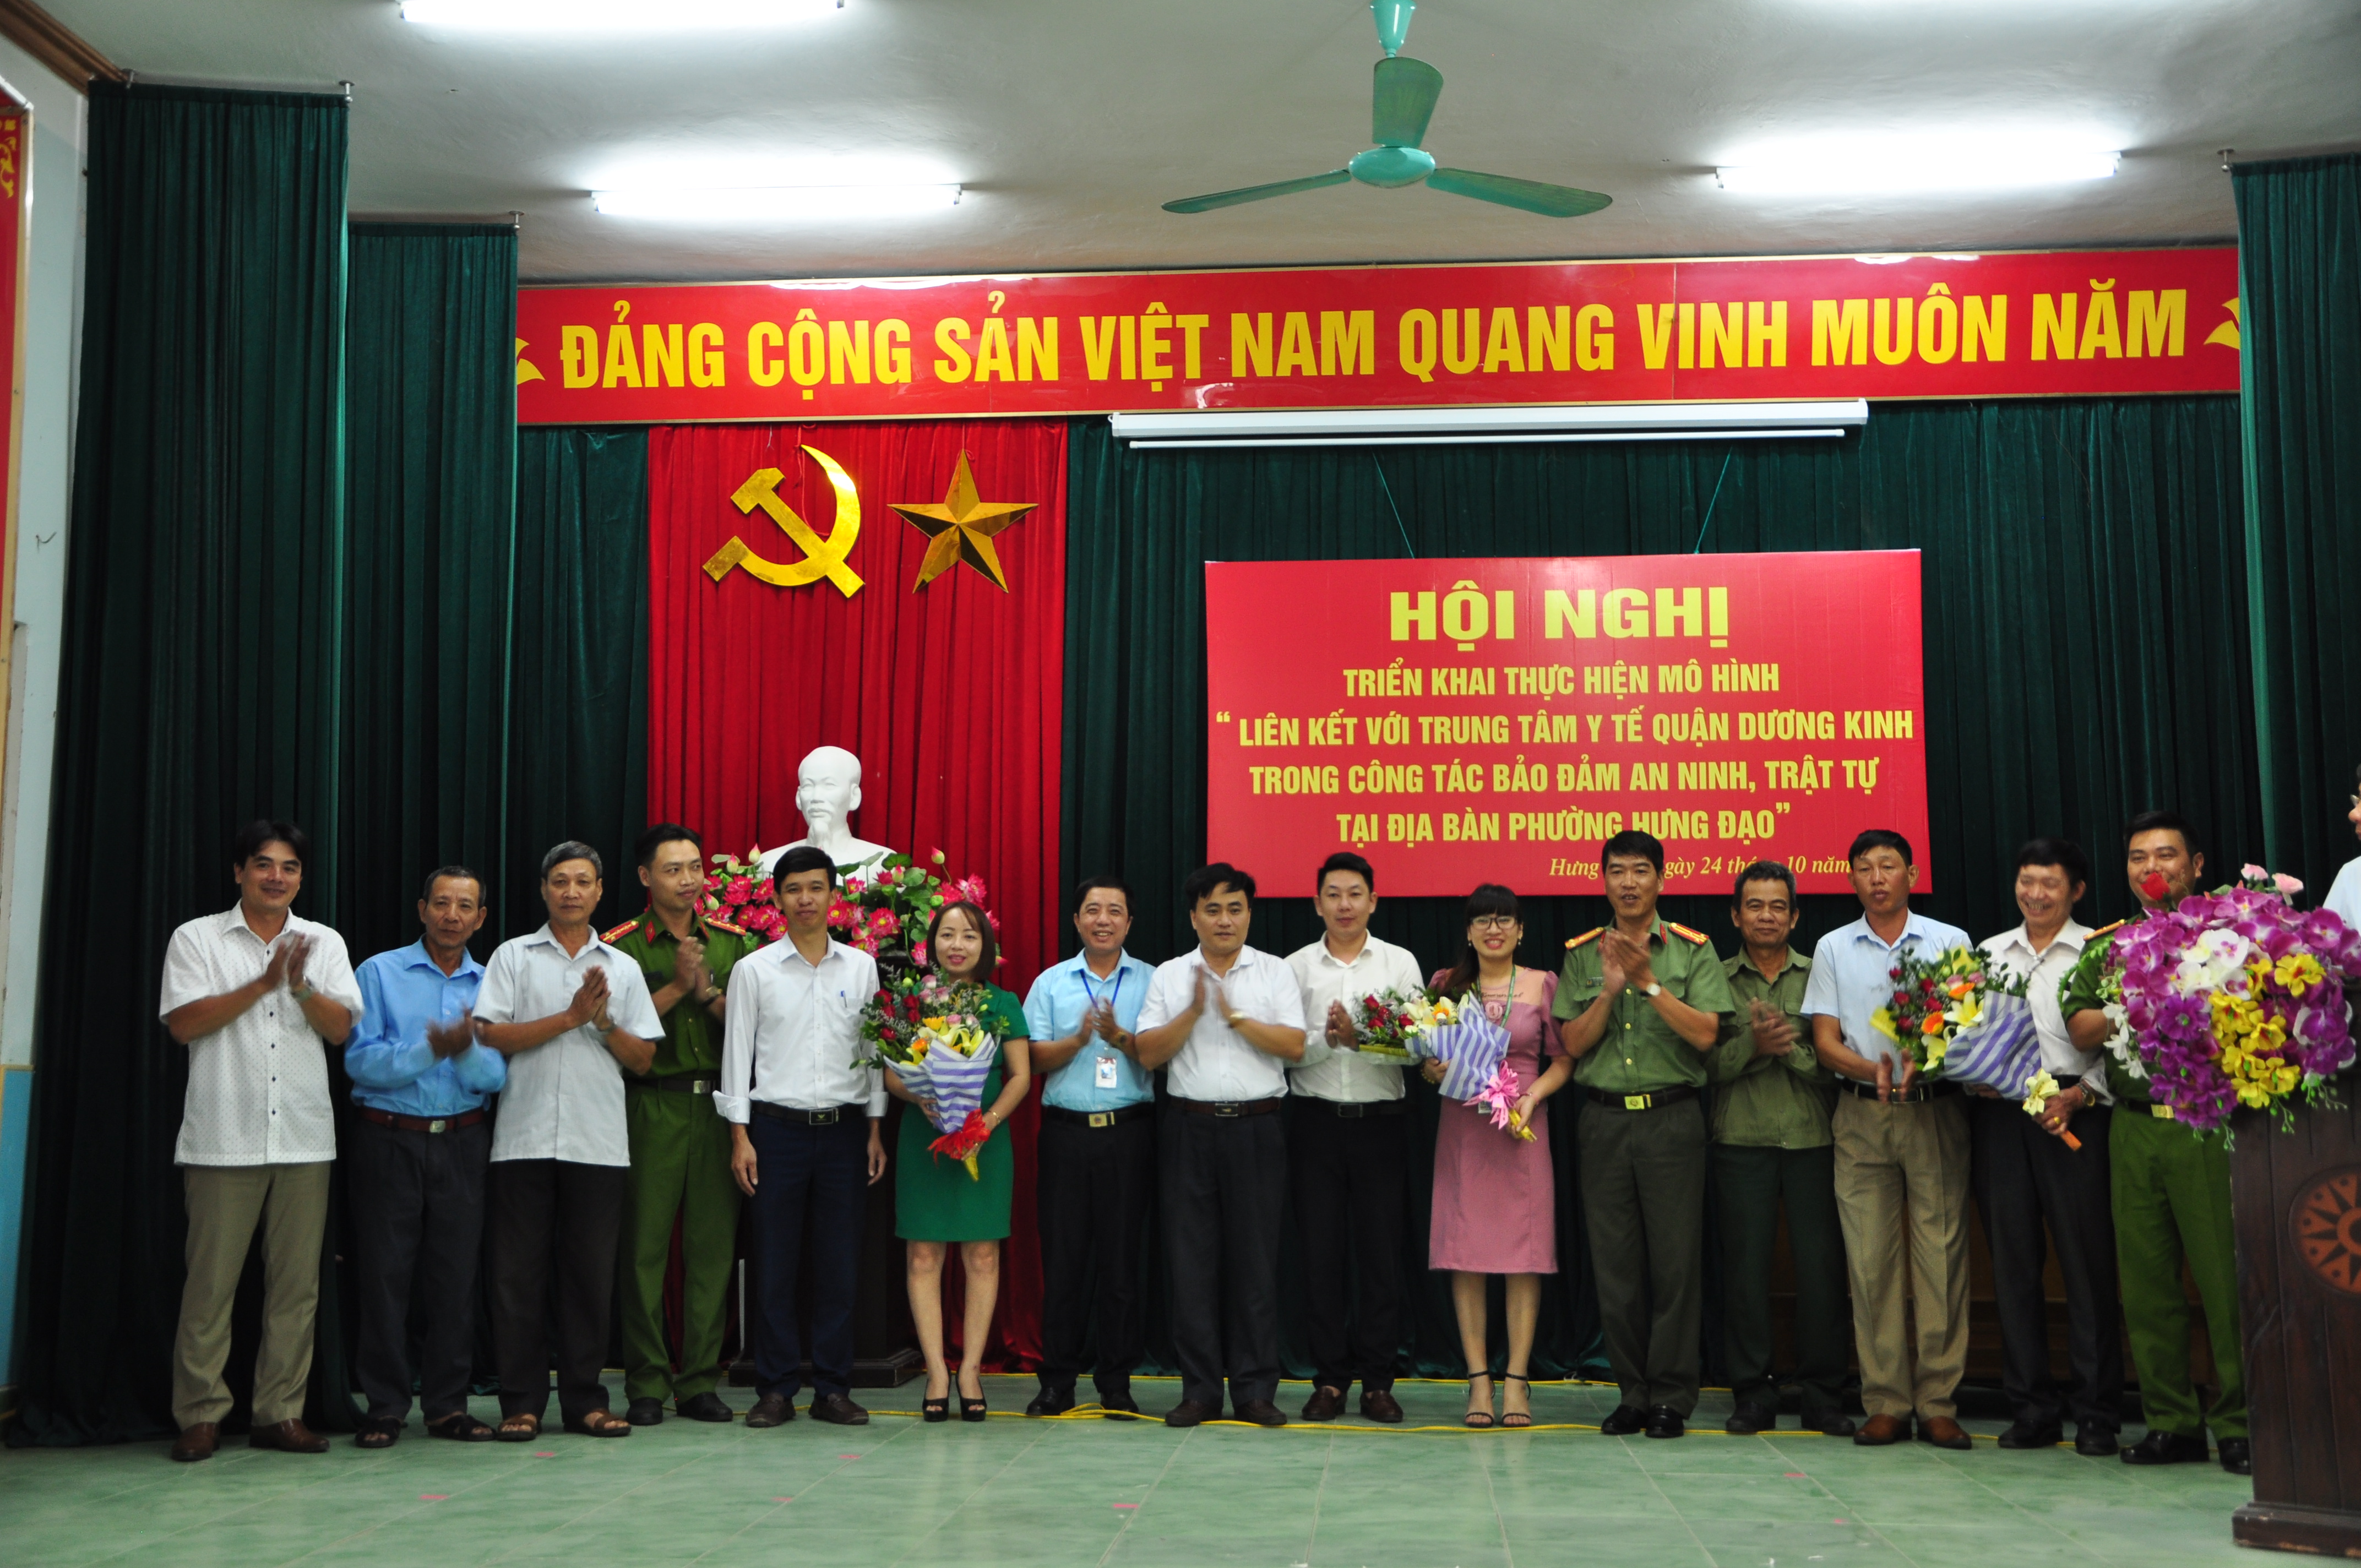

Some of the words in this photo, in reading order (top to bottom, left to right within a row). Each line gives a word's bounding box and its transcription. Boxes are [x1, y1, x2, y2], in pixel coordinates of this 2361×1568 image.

[559, 299, 726, 390] ĐẢNG
[747, 307, 911, 400] CỘNG
[933, 289, 1059, 385] SẢN
[1079, 301, 1209, 392] VIỆT
[1231, 310, 1374, 378] NAM
[1399, 303, 1614, 383] QUANG
[1636, 300, 1788, 369] VINH
[1811, 282, 2008, 367] MUÔN
[2031, 278, 2186, 361] NĂM
[1389, 579, 1516, 652] HỘI
[1543, 585, 1730, 649] NGHỊ
[1342, 657, 1423, 698] TRIỂN
[1431, 666, 1495, 696] KHAI
[1503, 663, 1575, 701] THỰC
[1583, 658, 1650, 701] HIỆN
[1657, 658, 1703, 694] MÔ
[1711, 657, 1780, 693] HÌNH
[1239, 709, 1300, 747] LIÊN
[1308, 708, 1358, 746] KẾT
[1365, 710, 1410, 745] VỚI
[1418, 715, 1510, 745] TRUNG
[1517, 709, 1578, 744] TÂM
[1585, 714, 1604, 743] Y
[1611, 704, 1645, 743] TẾ
[1652, 706, 1729, 748] QUẬN
[1738, 709, 1835, 742] DƯƠNG
[1844, 710, 1913, 740] KINH
[1248, 765, 1340, 795] TRONG
[1348, 759, 1424, 794] CÔNG
[1431, 758, 1484, 793] TÁC
[1493, 754, 1548, 793] BẢO
[1556, 753, 1620, 792] ĐẢM
[1629, 762, 1669, 791] AN
[1677, 761, 1756, 793] NINH,
[1764, 754, 1834, 796] TRẬT
[1841, 756, 1880, 795] TỰ
[1336, 813, 1379, 849] TẠI
[1386, 813, 1434, 849] ĐỊA
[1442, 807, 1500, 842] BÀN
[1509, 806, 1623, 842] PHƯỜNG
[1631, 808, 1709, 840] HƯNG
[1549, 858, 1600, 880] Hưng
[1700, 856, 1722, 874] 24
[1787, 856, 1807, 874] 10
[1811, 856, 1851, 874] năm
